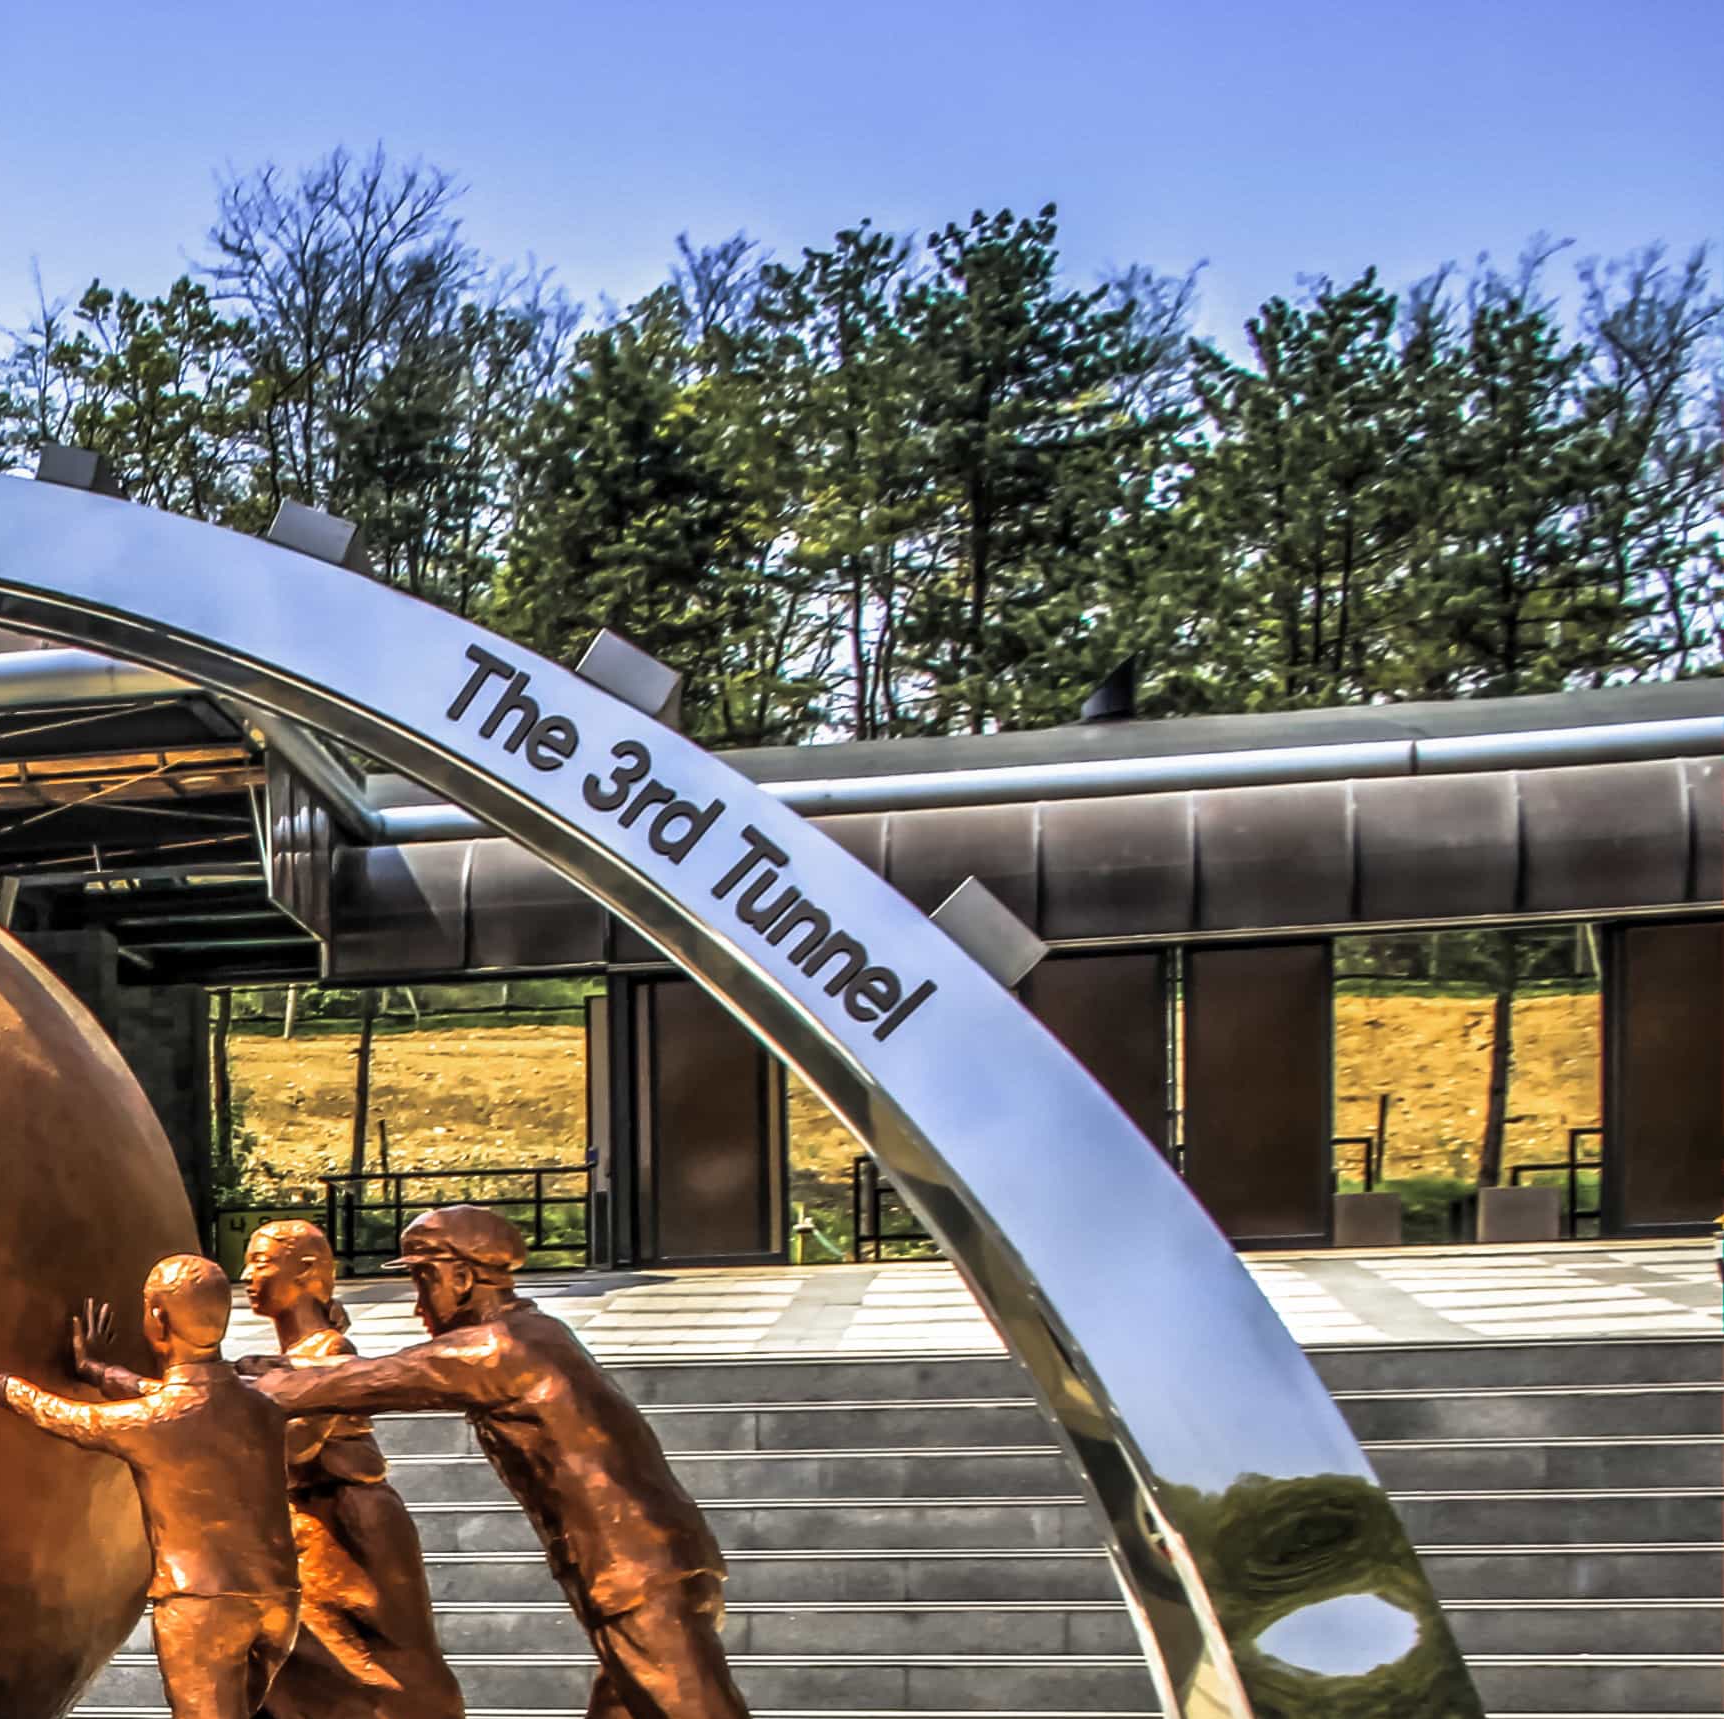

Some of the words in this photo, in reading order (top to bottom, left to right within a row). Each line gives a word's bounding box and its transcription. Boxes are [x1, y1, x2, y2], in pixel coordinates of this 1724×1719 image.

[445, 643, 579, 771] The
[582, 739, 726, 865] 3rd
[710, 824, 938, 1043] Tunnel
